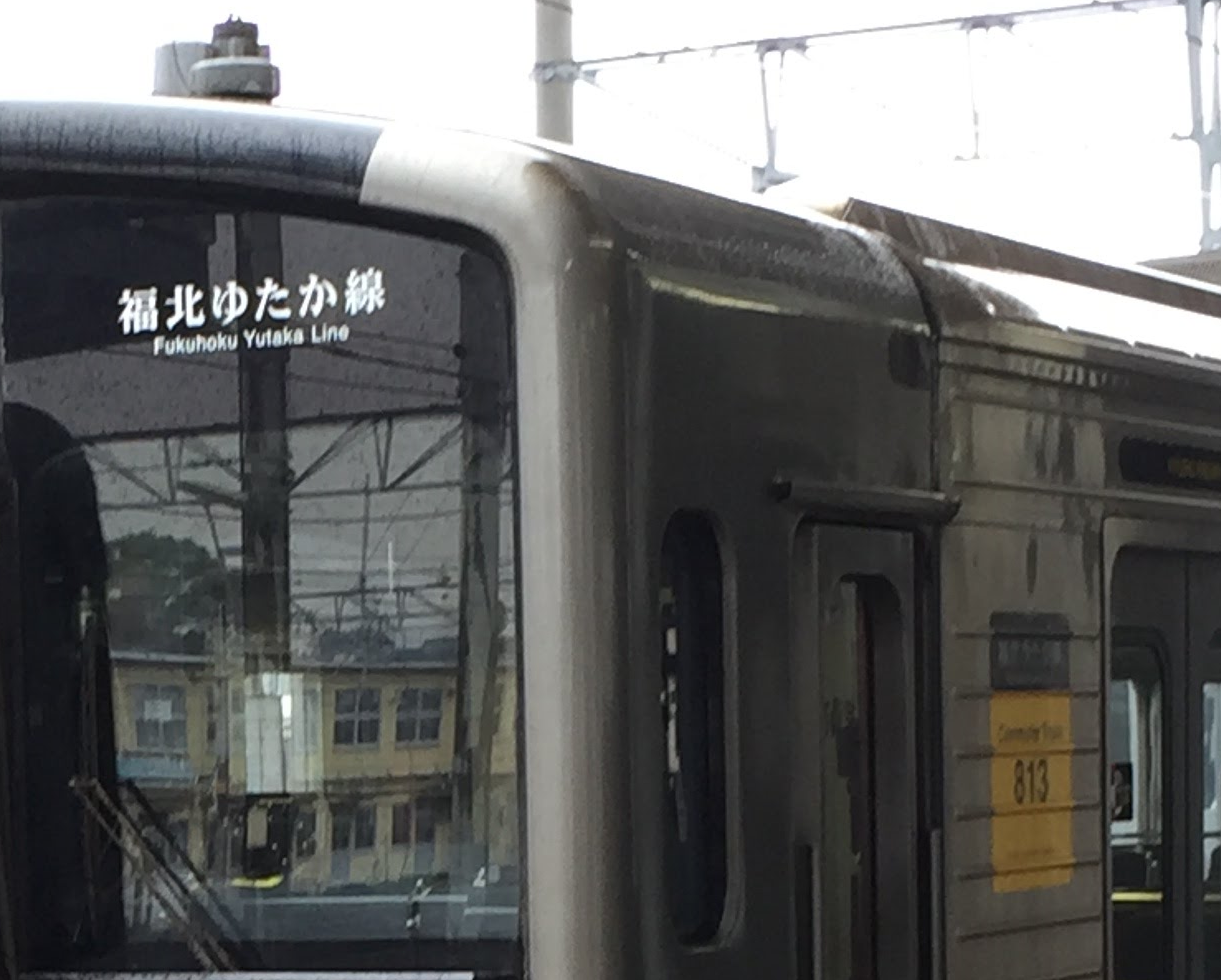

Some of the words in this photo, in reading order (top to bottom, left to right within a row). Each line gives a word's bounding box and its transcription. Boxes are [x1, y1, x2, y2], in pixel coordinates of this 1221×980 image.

[118, 266, 386, 335] 福北ゆたか線
[153, 331, 238, 356] Fukuhoku
[243, 326, 304, 348] Yutaka
[311, 323, 350, 345] Line
[1013, 758, 1049, 805] 813
